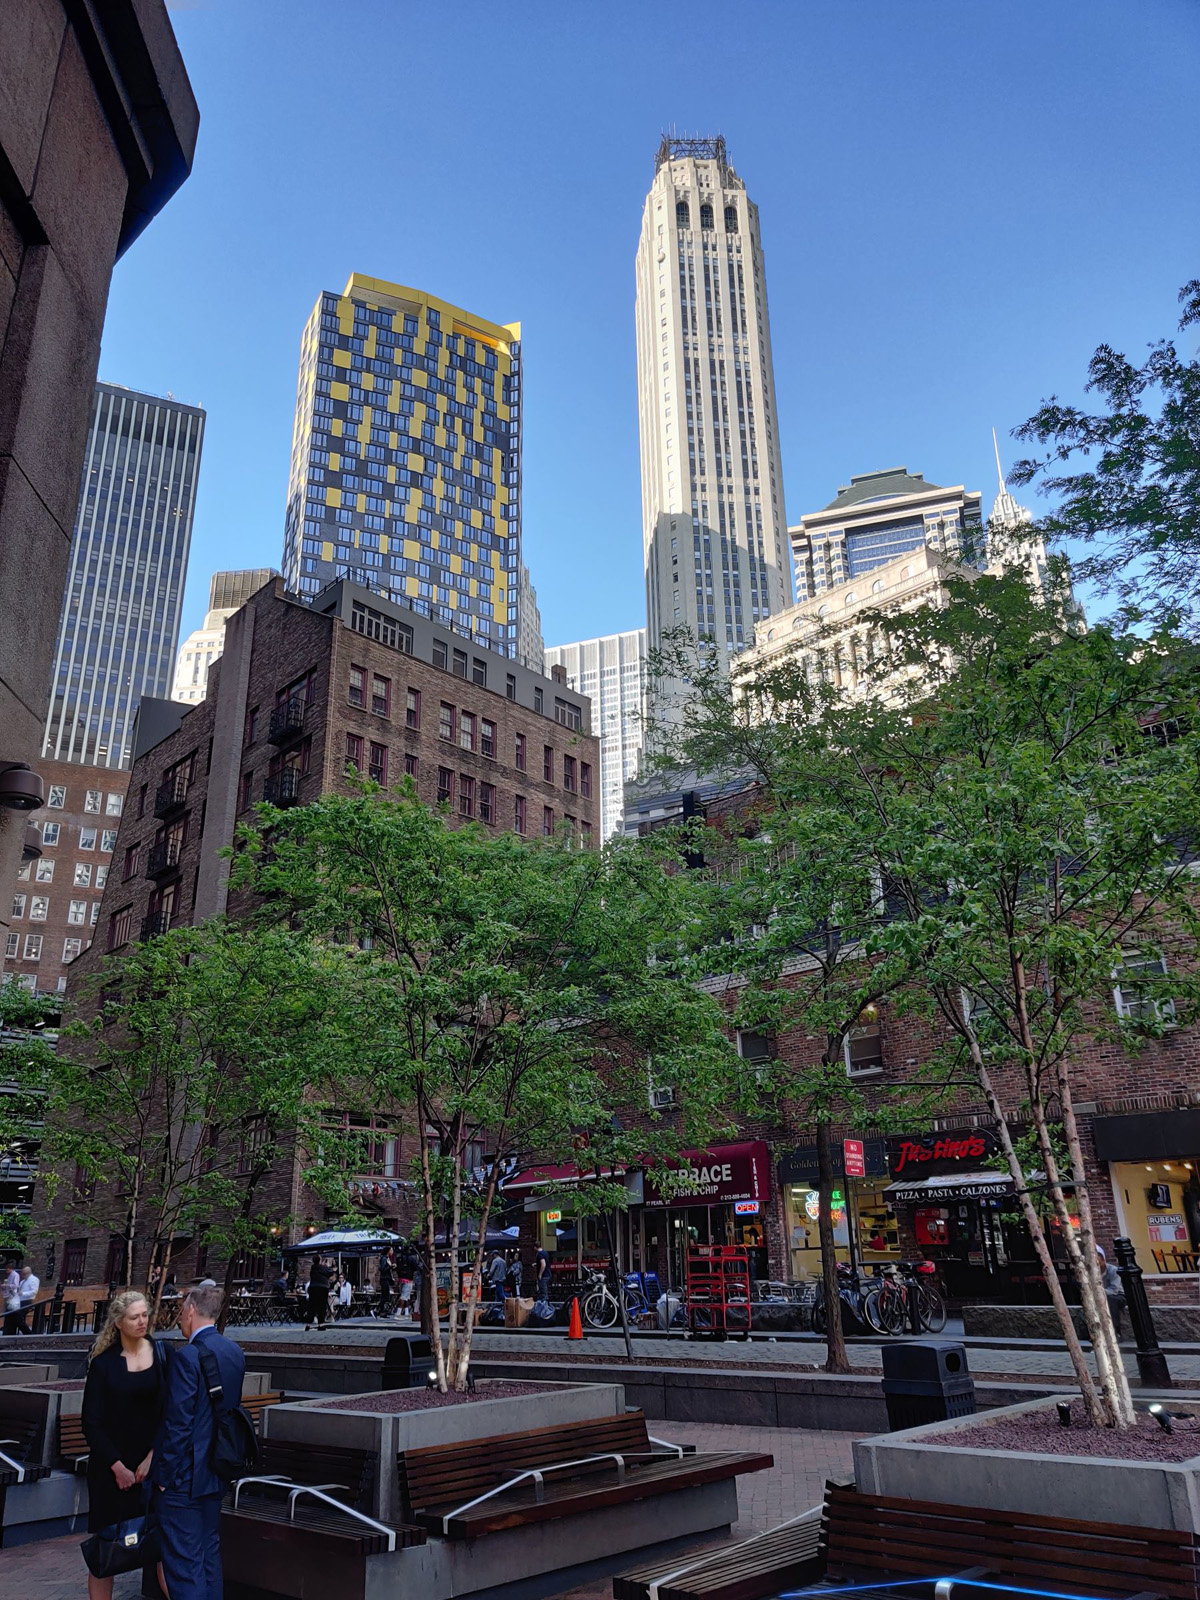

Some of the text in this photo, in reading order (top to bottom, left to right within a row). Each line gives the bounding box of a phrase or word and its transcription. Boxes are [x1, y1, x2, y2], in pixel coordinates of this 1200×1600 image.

[850, 1143, 858, 1152] NO
[894, 1136, 985, 1173] Justino's
[790, 1159, 820, 1170] Golden
[661, 1164, 733, 1184] RRACE
[673, 1187, 691, 1197] FISH
[699, 1185, 719, 1196] CHIP
[895, 1184, 1007, 1200] PIZZA PASTA CALZONES
[736, 1203, 757, 1213] OPEN
[1149, 1216, 1182, 1225] RUBENS
